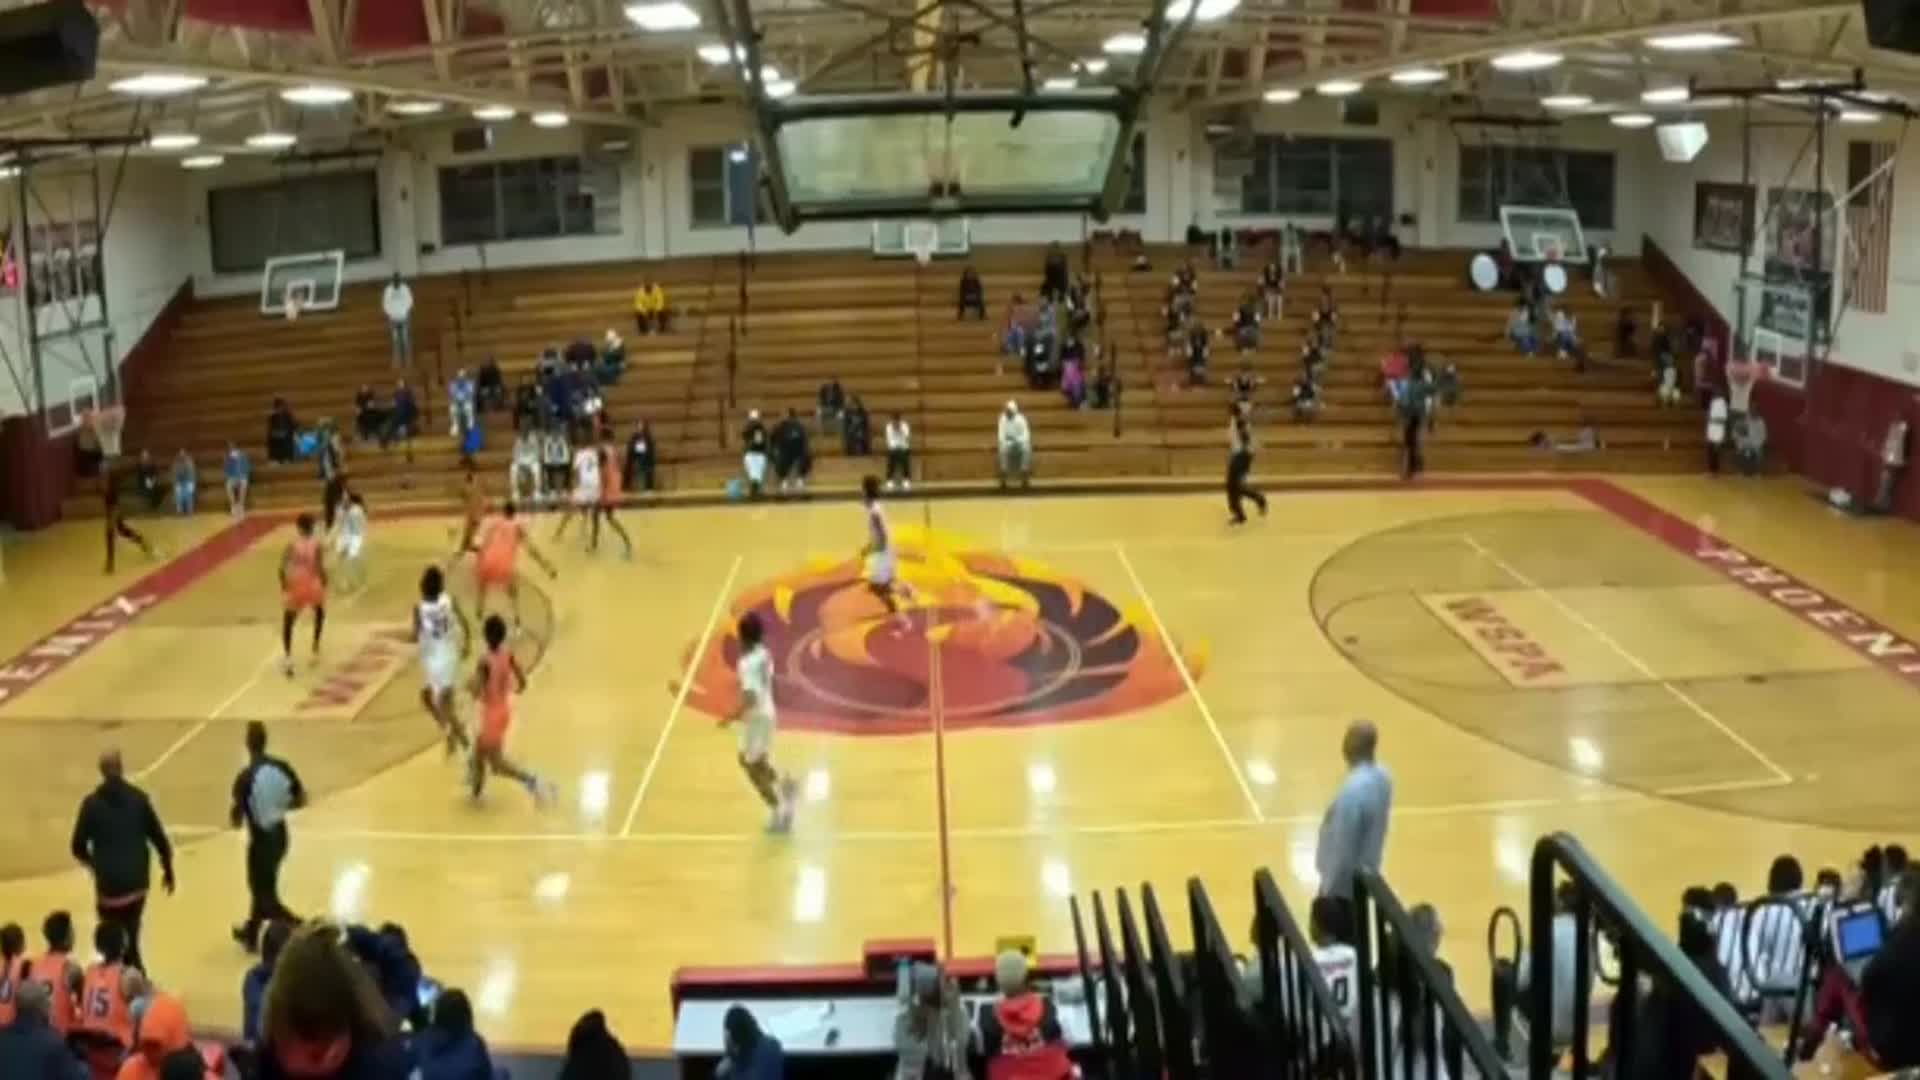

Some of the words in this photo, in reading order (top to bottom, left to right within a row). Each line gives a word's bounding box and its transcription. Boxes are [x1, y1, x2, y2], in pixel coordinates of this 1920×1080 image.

[0, 595, 158, 700] ENIX
[1444, 599, 1565, 680] WSPA
[85, 984, 112, 1018] 15
